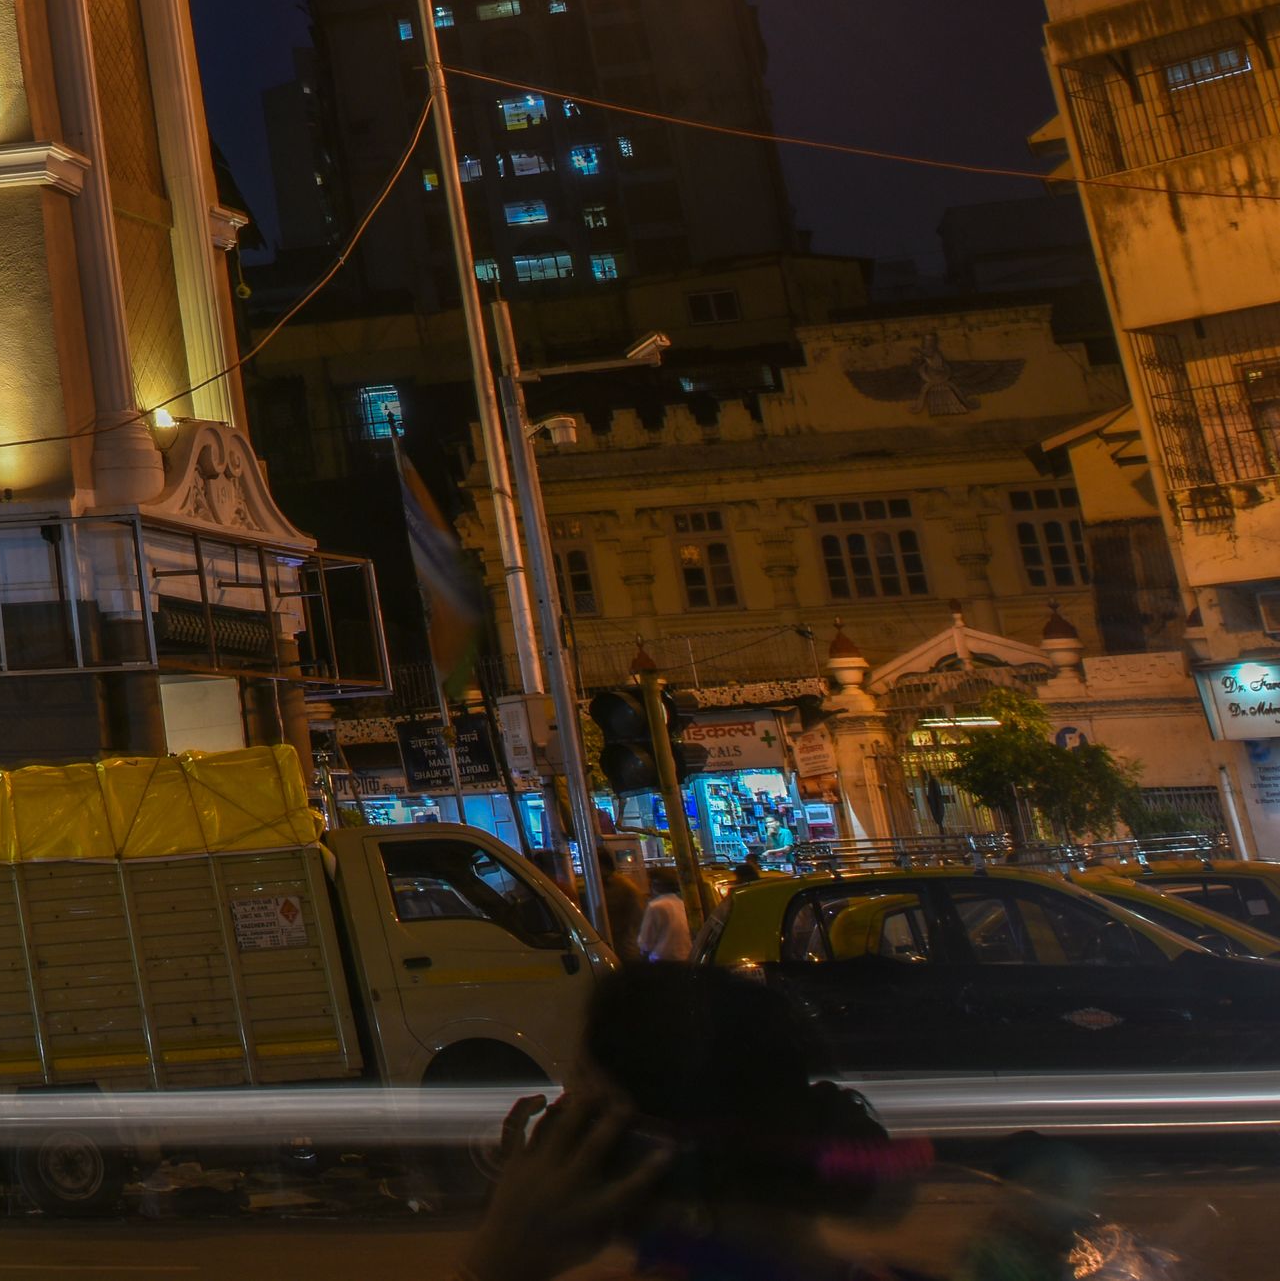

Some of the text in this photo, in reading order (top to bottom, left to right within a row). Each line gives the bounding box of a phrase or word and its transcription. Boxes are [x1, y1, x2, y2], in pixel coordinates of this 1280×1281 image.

[1222, 676, 1246, 693] Dr.
[1229, 702, 1248, 716] Dr.
[686, 722, 757, 741] डिकल्स
[708, 745, 742, 758] CALS
[428, 756, 472, 768] MAULNA
[414, 767, 452, 781] SHAUKAT
[467, 764, 490, 775] ROAD
